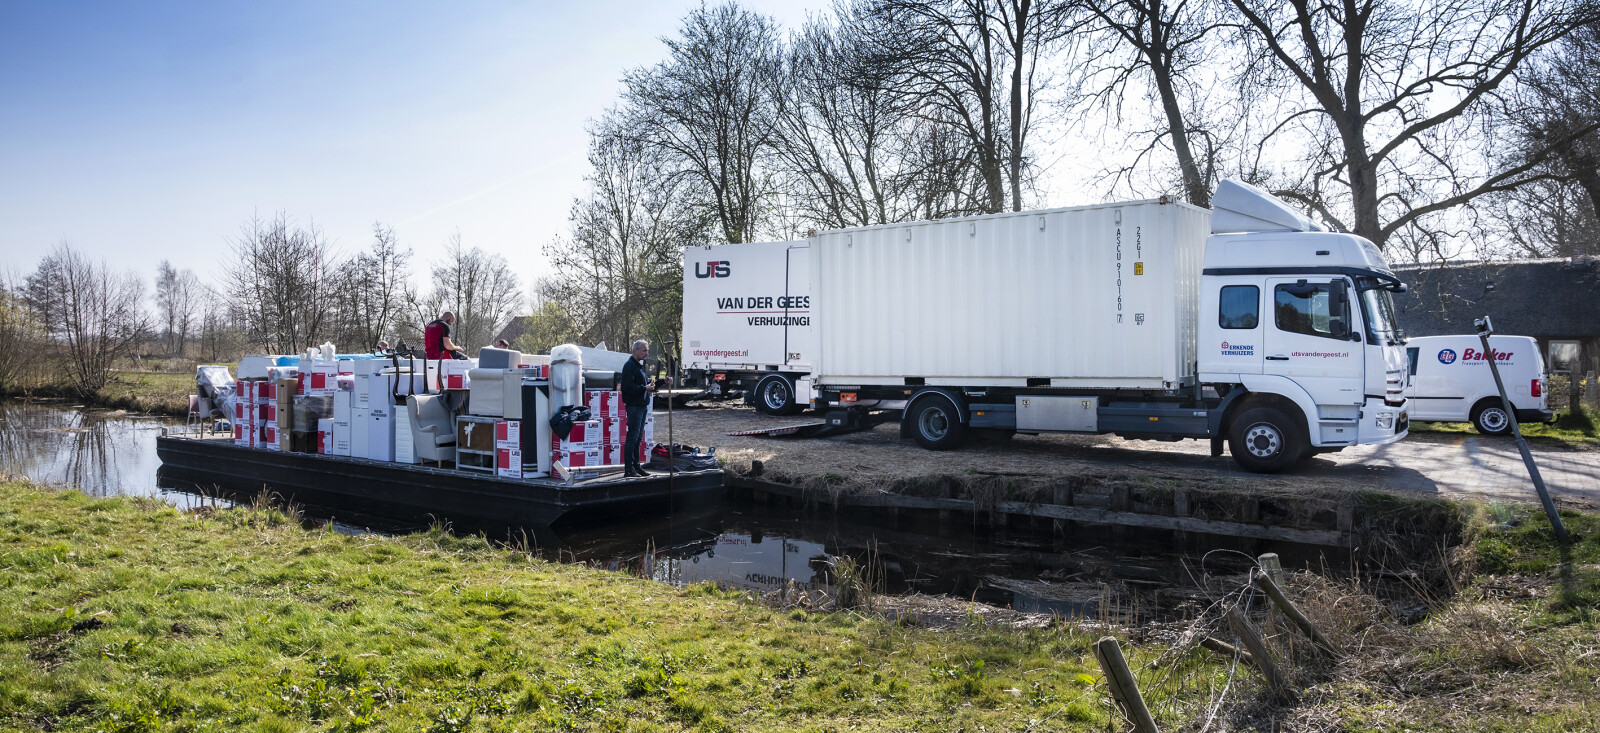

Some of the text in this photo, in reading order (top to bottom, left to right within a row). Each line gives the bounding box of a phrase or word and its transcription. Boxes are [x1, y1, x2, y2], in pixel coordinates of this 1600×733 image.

[695, 261, 730, 278] UTS
[717, 297, 743, 309] VAN
[747, 297, 772, 309] DER
[693, 349, 748, 358] utsvandergeest.nl
[1462, 348, 1514, 360] Bakker
